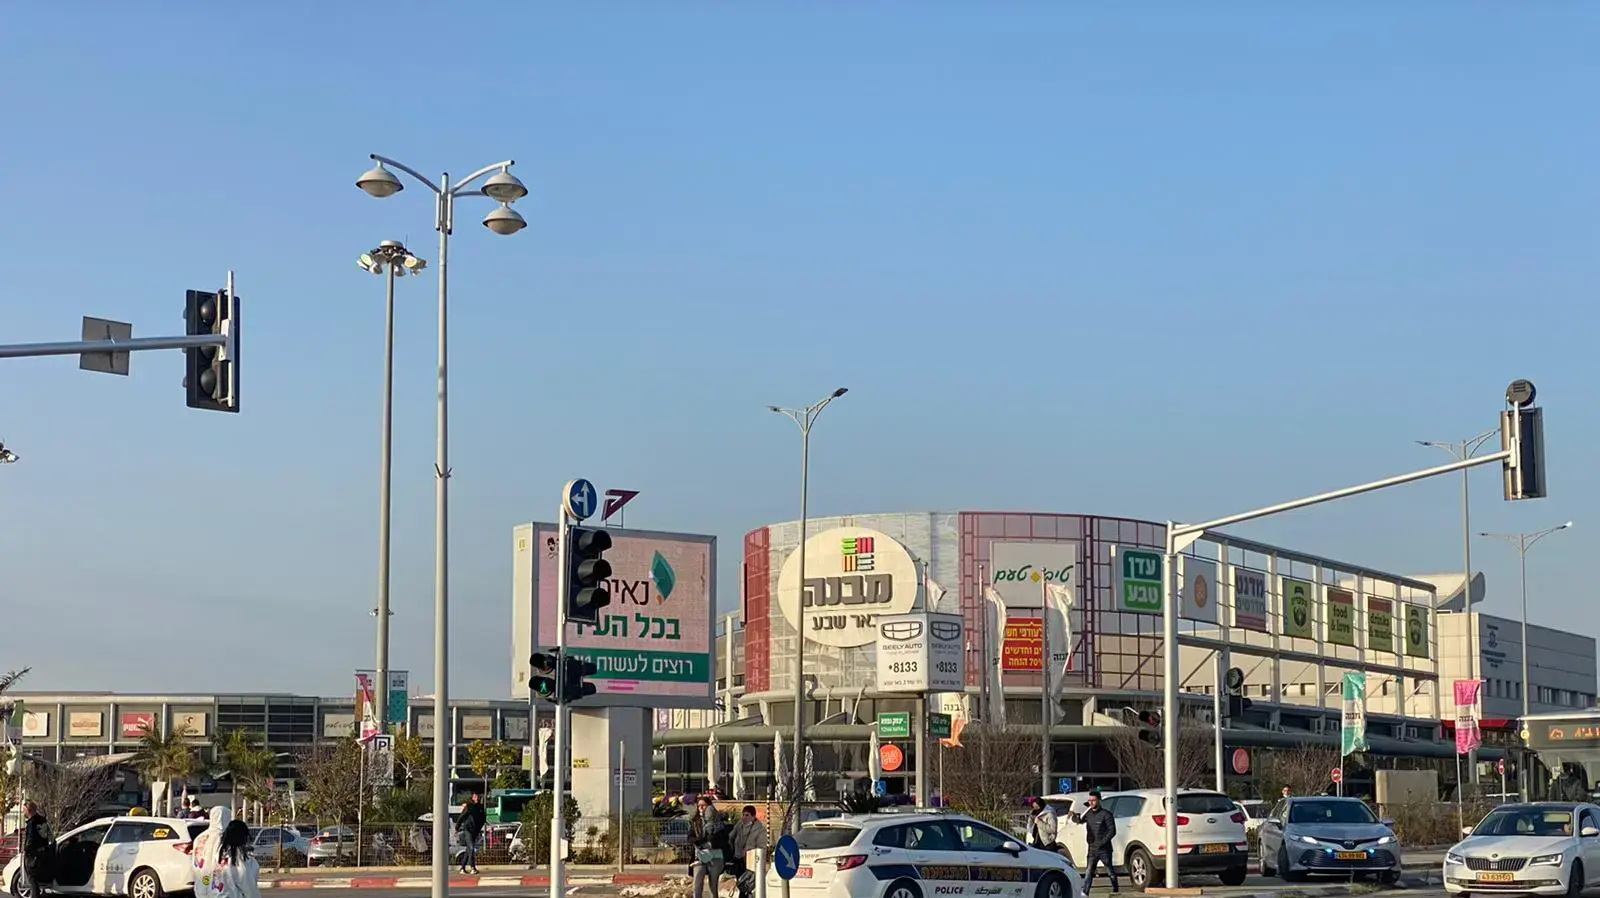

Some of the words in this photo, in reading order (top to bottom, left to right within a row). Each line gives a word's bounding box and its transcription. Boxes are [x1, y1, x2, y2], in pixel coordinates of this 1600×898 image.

[994, 565, 1032, 583] טעם
[1128, 556, 1155, 579] עדן
[804, 574, 892, 607] מבנה
[1127, 584, 1157, 603] טבע
[636, 613, 680, 639] בכל
[812, 615, 846, 630] שבע
[597, 653, 647, 672] לעשות
[653, 660, 693, 674] רוצים
[944, 703, 961, 711] בנה
[935, 886, 964, 894] POLICE
